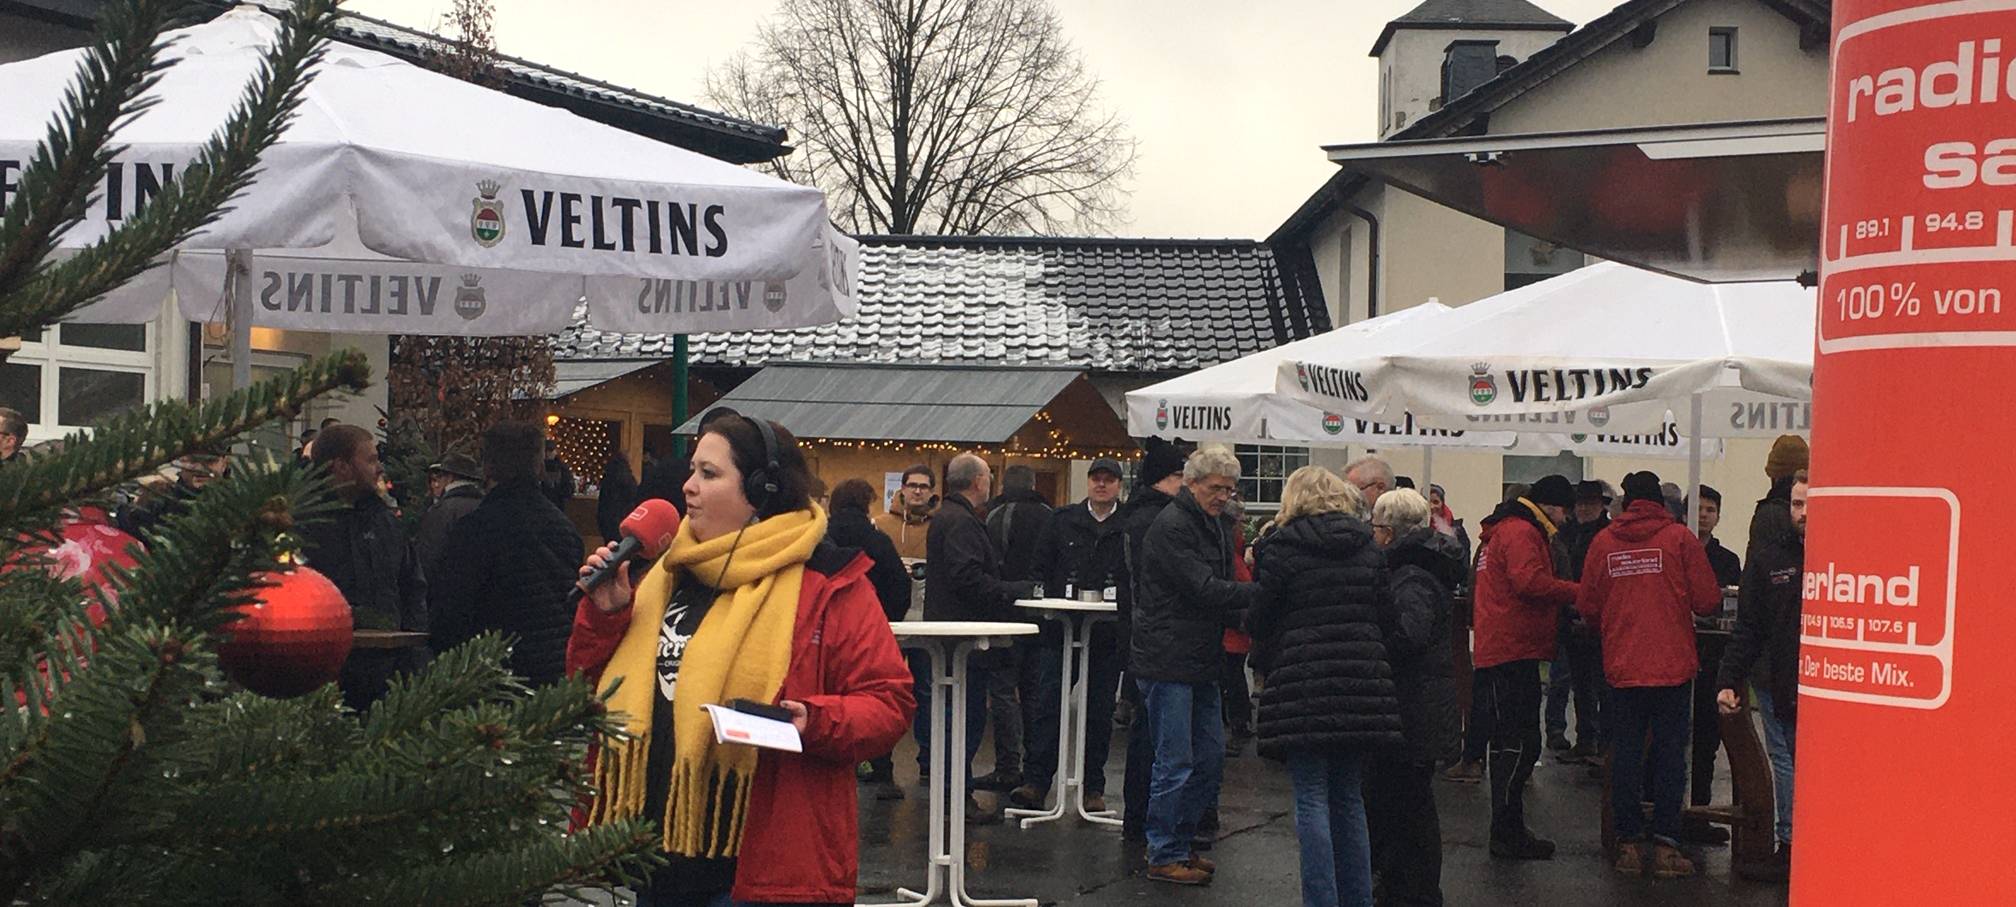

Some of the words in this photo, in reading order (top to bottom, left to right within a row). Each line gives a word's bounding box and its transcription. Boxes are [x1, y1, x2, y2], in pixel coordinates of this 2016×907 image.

[520, 189, 728, 257] VELTINS
[1856, 218, 1890, 239] 89.1
[1925, 211, 1984, 232] 94.8
[1934, 287, 2000, 315] von
[1307, 363, 1369, 402] VELTINS
[1505, 366, 1652, 403] VELTINS
[1173, 405, 1232, 431] VELTINS
[1869, 619, 1903, 633] 107.6
[1804, 655, 1820, 678] Der
[1823, 657, 1864, 683] beste
[1871, 662, 1914, 688] Mix.
